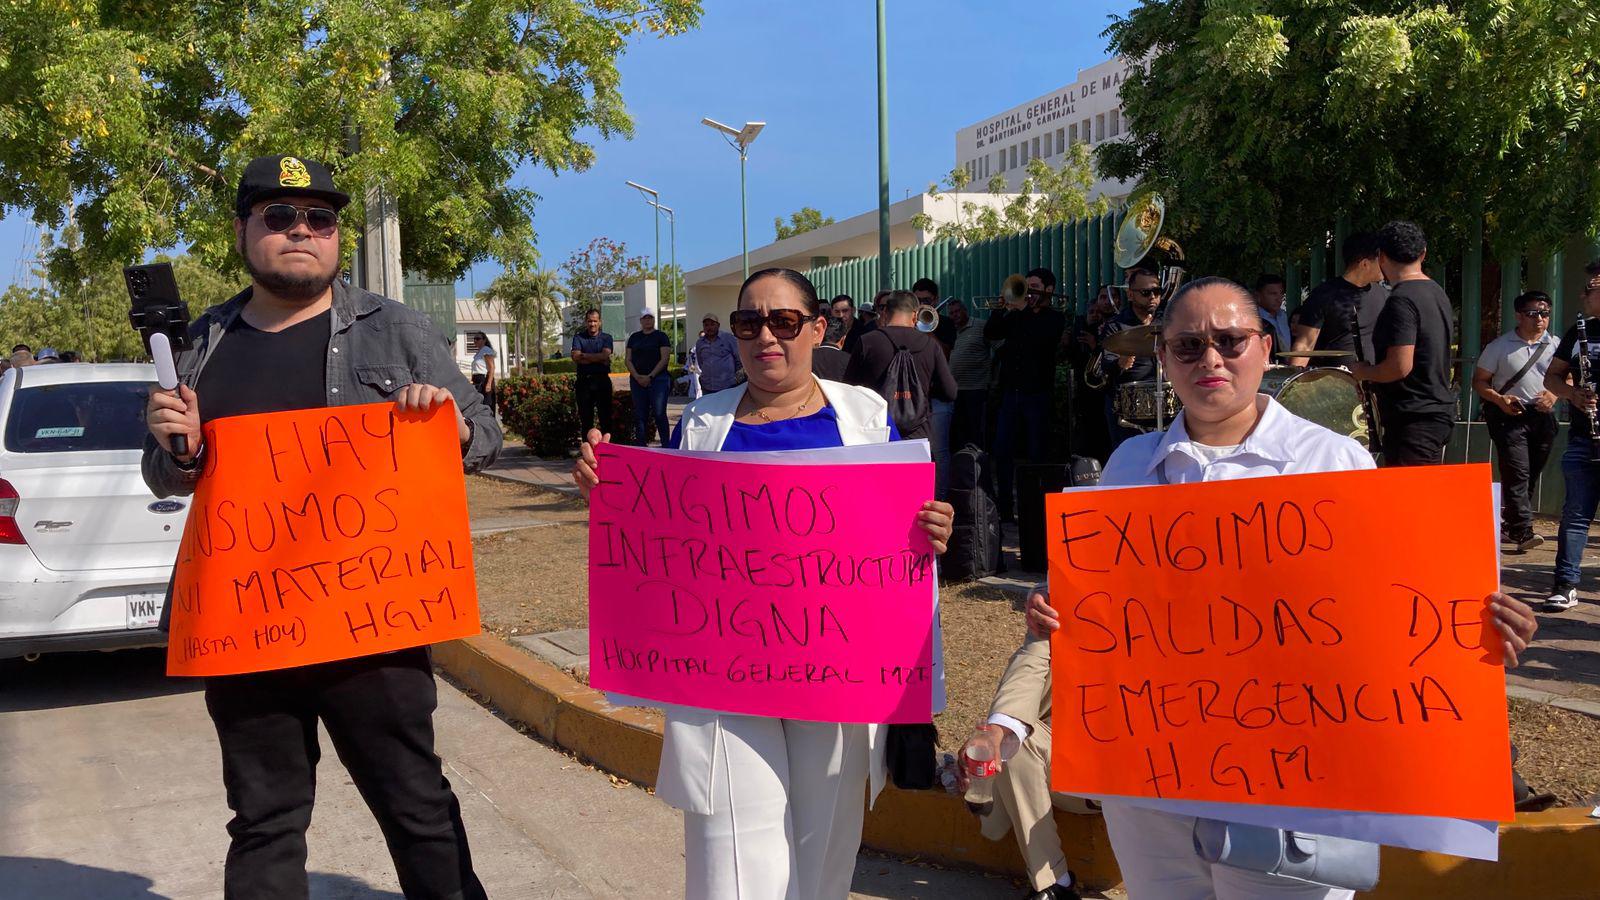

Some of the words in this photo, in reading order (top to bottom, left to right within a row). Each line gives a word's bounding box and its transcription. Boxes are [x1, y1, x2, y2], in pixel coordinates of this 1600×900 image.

[976, 115, 1022, 139] HOSPITAL
[1026, 91, 1076, 120] GENERAL
[1081, 81, 1097, 98] DE
[989, 122, 1032, 145] MARTINIANO
[1036, 104, 1076, 126] CARVAJAL
[265, 410, 399, 483] HAY
[155, 502, 177, 512] Ford
[598, 453, 840, 537] EXIGIMOS
[595, 521, 933, 588] INFRAESTRUCTURA
[1061, 499, 1336, 574] EXIGIMOS
[177, 582, 203, 616] NI
[232, 538, 466, 614] MATERIAL
[635, 579, 850, 648] DIGNA
[1073, 591, 1344, 658] SALIDAS
[1391, 583, 1484, 667] DE
[726, 655, 864, 685] GENERAL
[1077, 675, 1463, 743] EMERGENCIA
